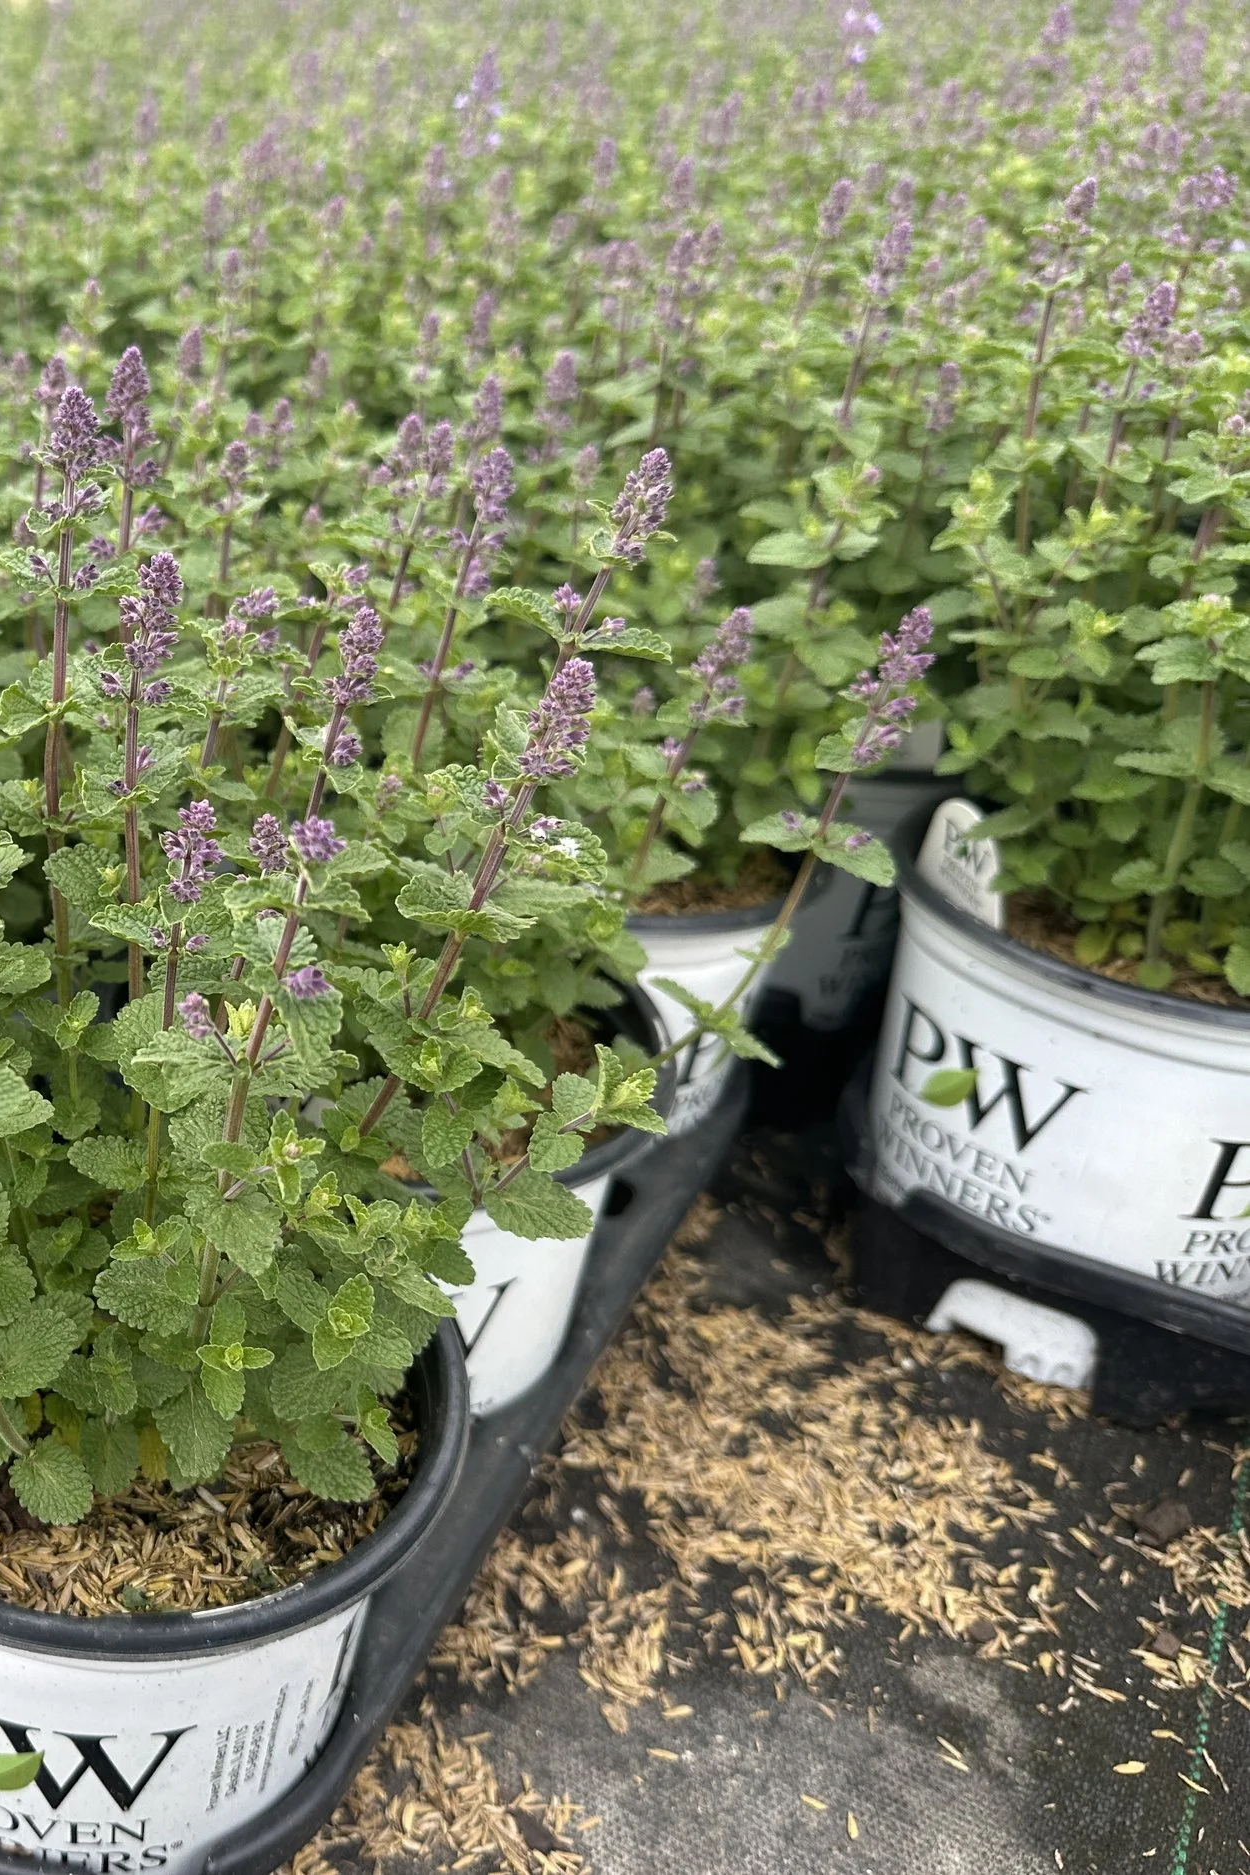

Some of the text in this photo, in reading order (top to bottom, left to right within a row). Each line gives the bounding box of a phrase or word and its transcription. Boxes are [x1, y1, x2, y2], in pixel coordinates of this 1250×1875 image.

[891, 993, 1092, 1152] PW
[890, 1089, 1037, 1194] PROVEN
[1177, 1136, 1250, 1221] P
